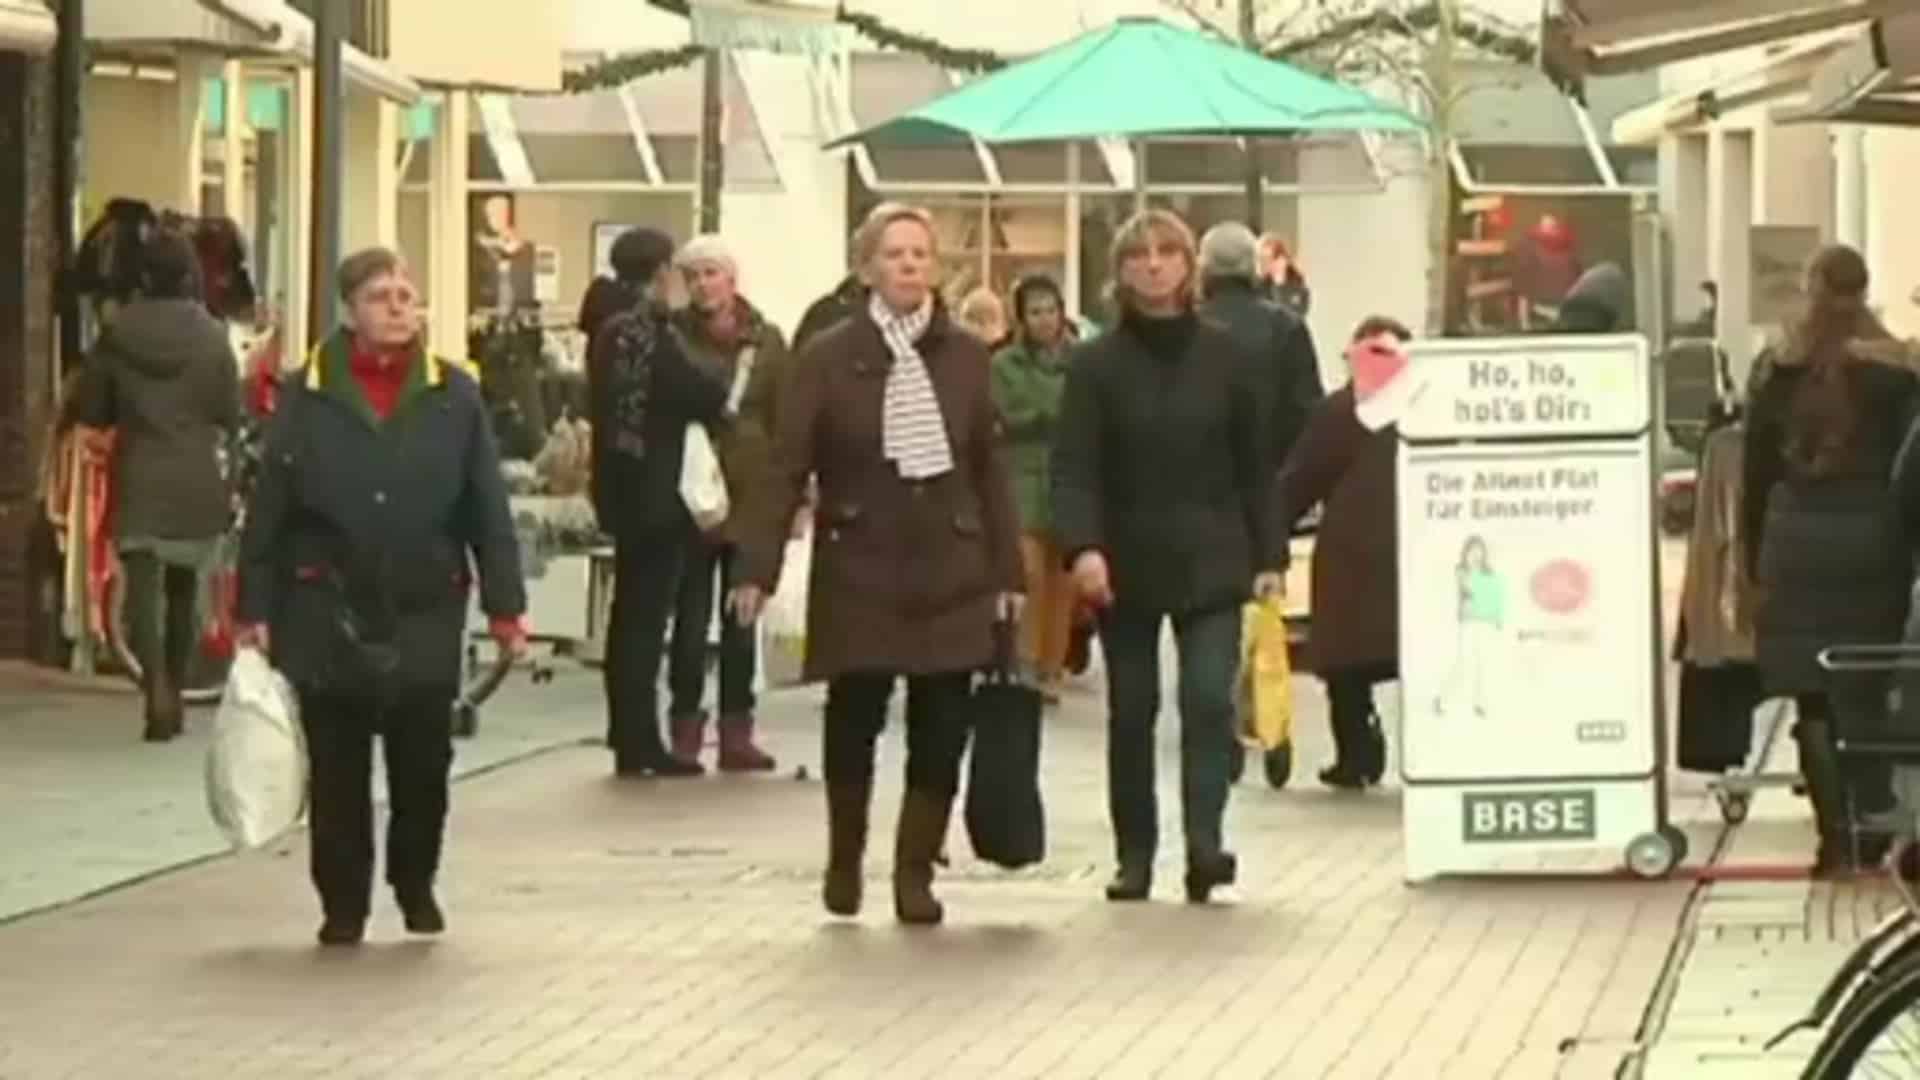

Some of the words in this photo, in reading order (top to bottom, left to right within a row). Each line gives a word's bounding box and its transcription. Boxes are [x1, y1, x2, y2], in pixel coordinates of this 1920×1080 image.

[1468, 359, 1519, 389] Ho,
[1528, 358, 1577, 388] ho,
[1472, 798, 1586, 833] BASE
